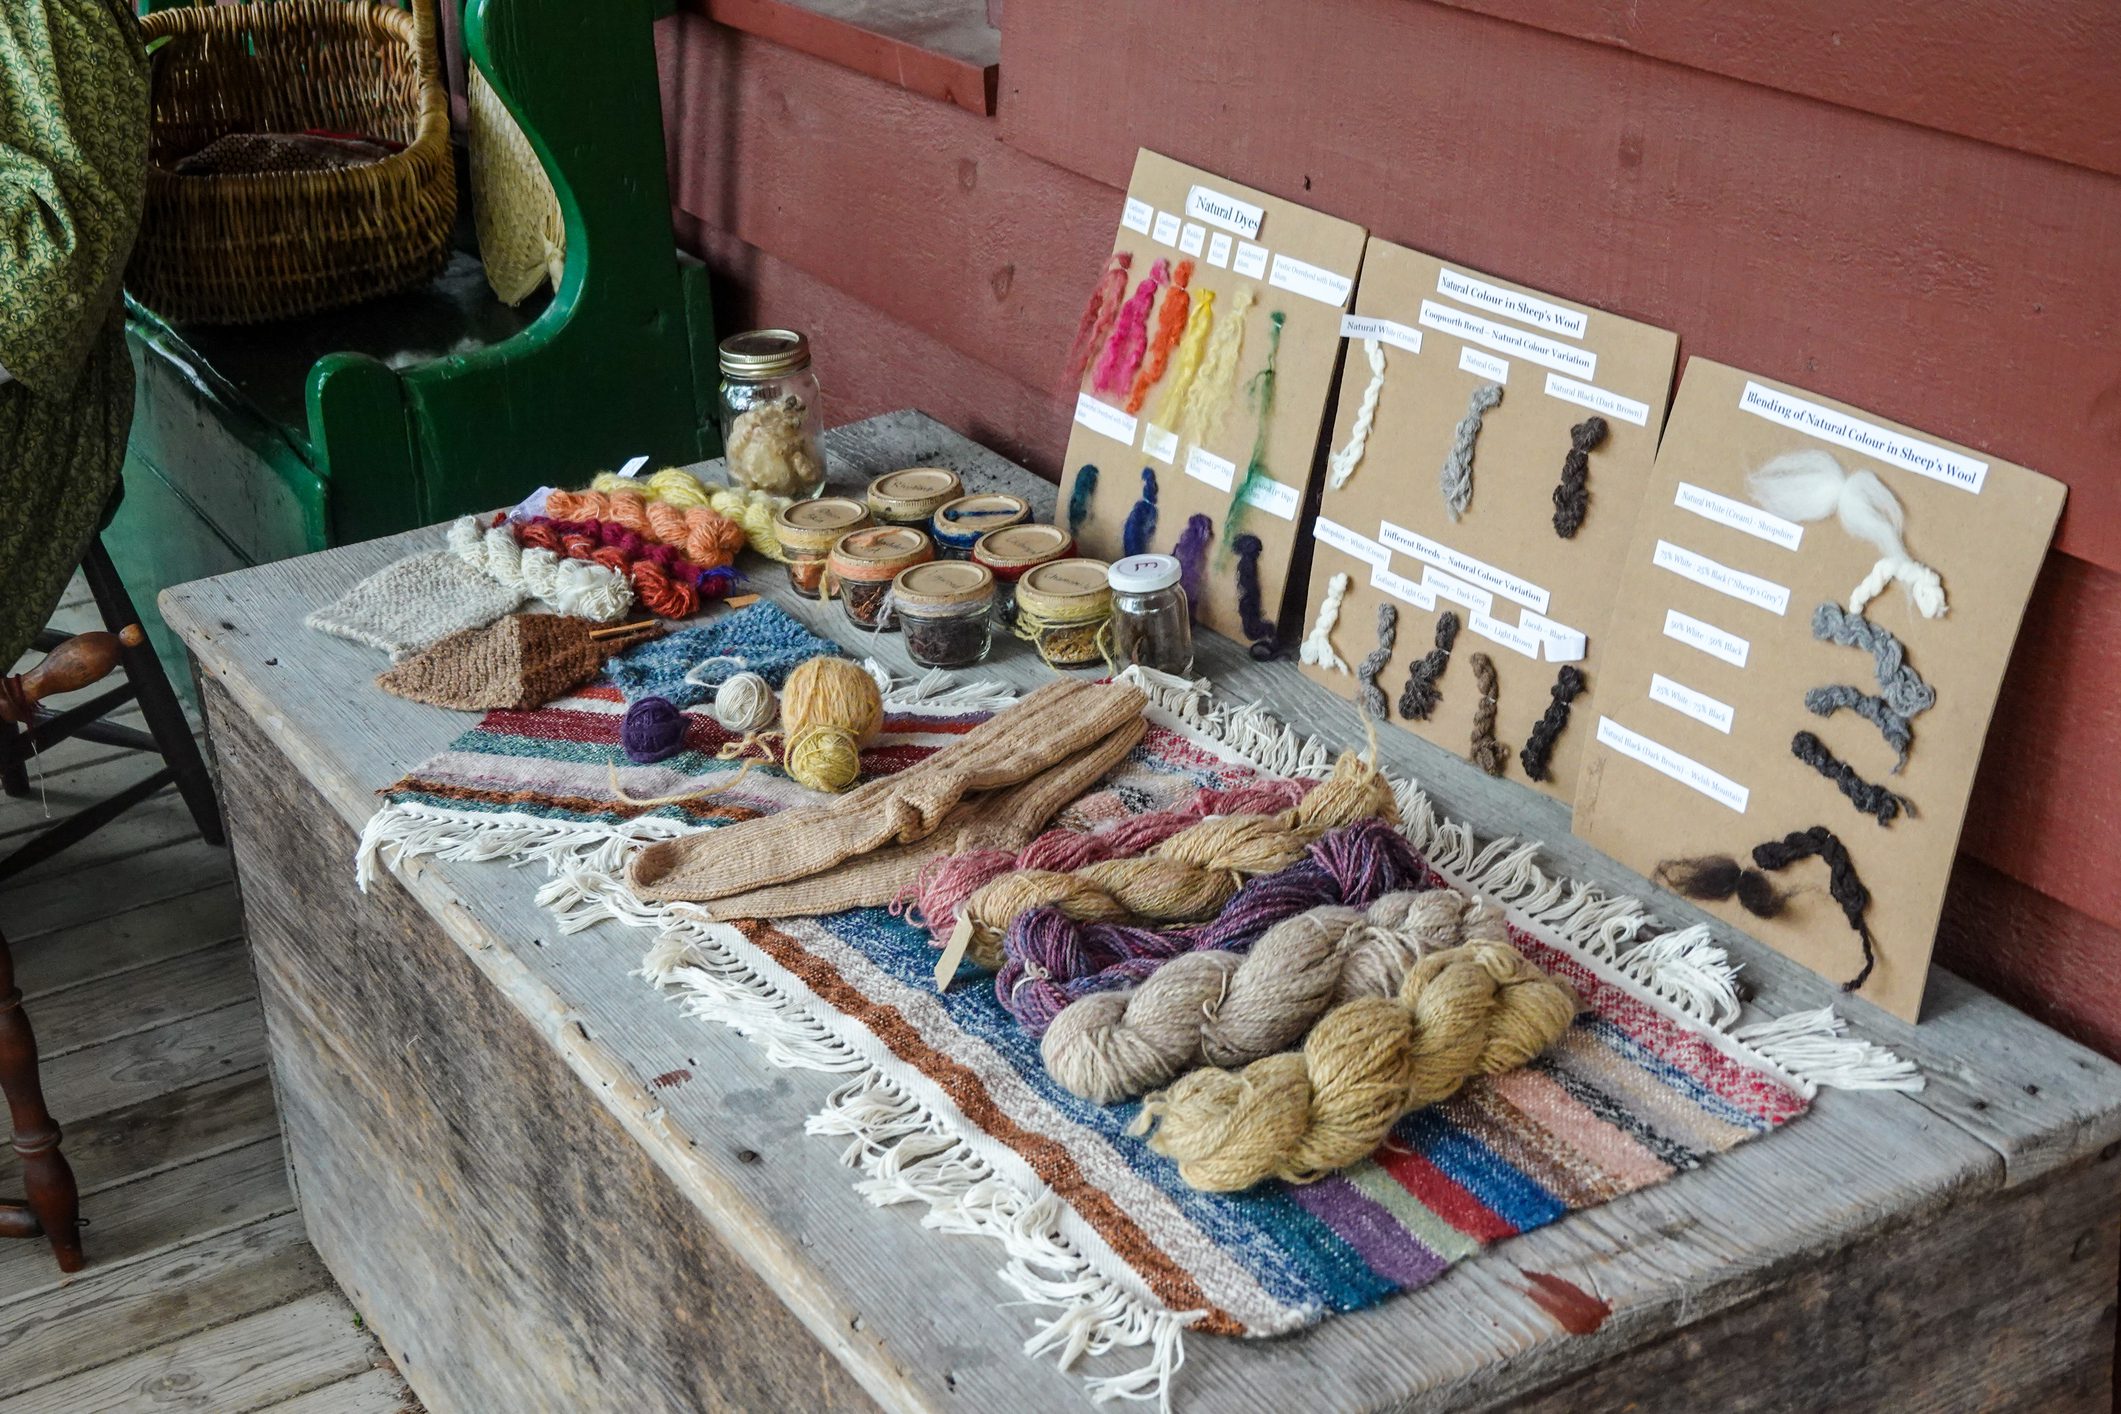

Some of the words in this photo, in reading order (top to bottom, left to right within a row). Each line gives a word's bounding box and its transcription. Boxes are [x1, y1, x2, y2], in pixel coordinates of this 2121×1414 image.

[1195, 195, 1234, 221] Natural
[1233, 209, 1258, 229] Dyes
[1442, 275, 1470, 295] Natural
[1470, 287, 1504, 306] Colour
[1504, 296, 1516, 310] in
[1516, 301, 1551, 322] Sheep's
[1554, 313, 1580, 331] Wool
[1346, 320, 1377, 333] Natural
[1424, 308, 1463, 328] Coopworth
[1463, 320, 1485, 335] Breed
[1492, 329, 1523, 347] Natural
[1523, 339, 1550, 355] Colour
[1551, 347, 1590, 368] Variation
[1465, 353, 1488, 369] Natural
[1487, 362, 1502, 377] Grey
[1550, 381, 1576, 397] Natural
[1576, 389, 1594, 402] Black
[1595, 396, 1614, 409] (Dark
[1615, 402, 1643, 419] Brown)
[1746, 390, 1792, 419] Blending
[1792, 409, 1807, 421] of
[1805, 412, 1847, 436] Natural
[1847, 428, 1885, 450] Colour
[1886, 440, 1898, 456] in
[1899, 447, 1942, 472] Sheep's
[1946, 463, 1977, 484] Wool
[1681, 489, 1705, 507] Natural
[1704, 498, 1725, 514] White
[1725, 506, 1753, 527] (Cream)
[1757, 519, 1794, 541] Shropshire
[1383, 528, 1415, 548] Different
[1415, 541, 1441, 560] Breeds
[1448, 555, 1477, 575] Natural
[1476, 568, 1503, 585] Colour
[1504, 579, 1541, 603] Variation
[1673, 553, 1693, 568] White
[1416, 591, 1430, 605] Grey
[1455, 586, 1470, 600] Dark
[1471, 593, 1486, 608] Grey
[1493, 625, 1511, 640] Light
[1511, 633, 1533, 649] Brown
[1523, 618, 1543, 633] Jacob
[1685, 624, 1704, 640] White
[1723, 641, 1742, 656] Black
[1707, 707, 1726, 722] Black
[1602, 725, 1624, 744] Natural
[1623, 736, 1641, 752] Black
[1641, 745, 1660, 761] (Dark
[1690, 769, 1710, 787] Welsh
[1710, 780, 1743, 804] Mountain
